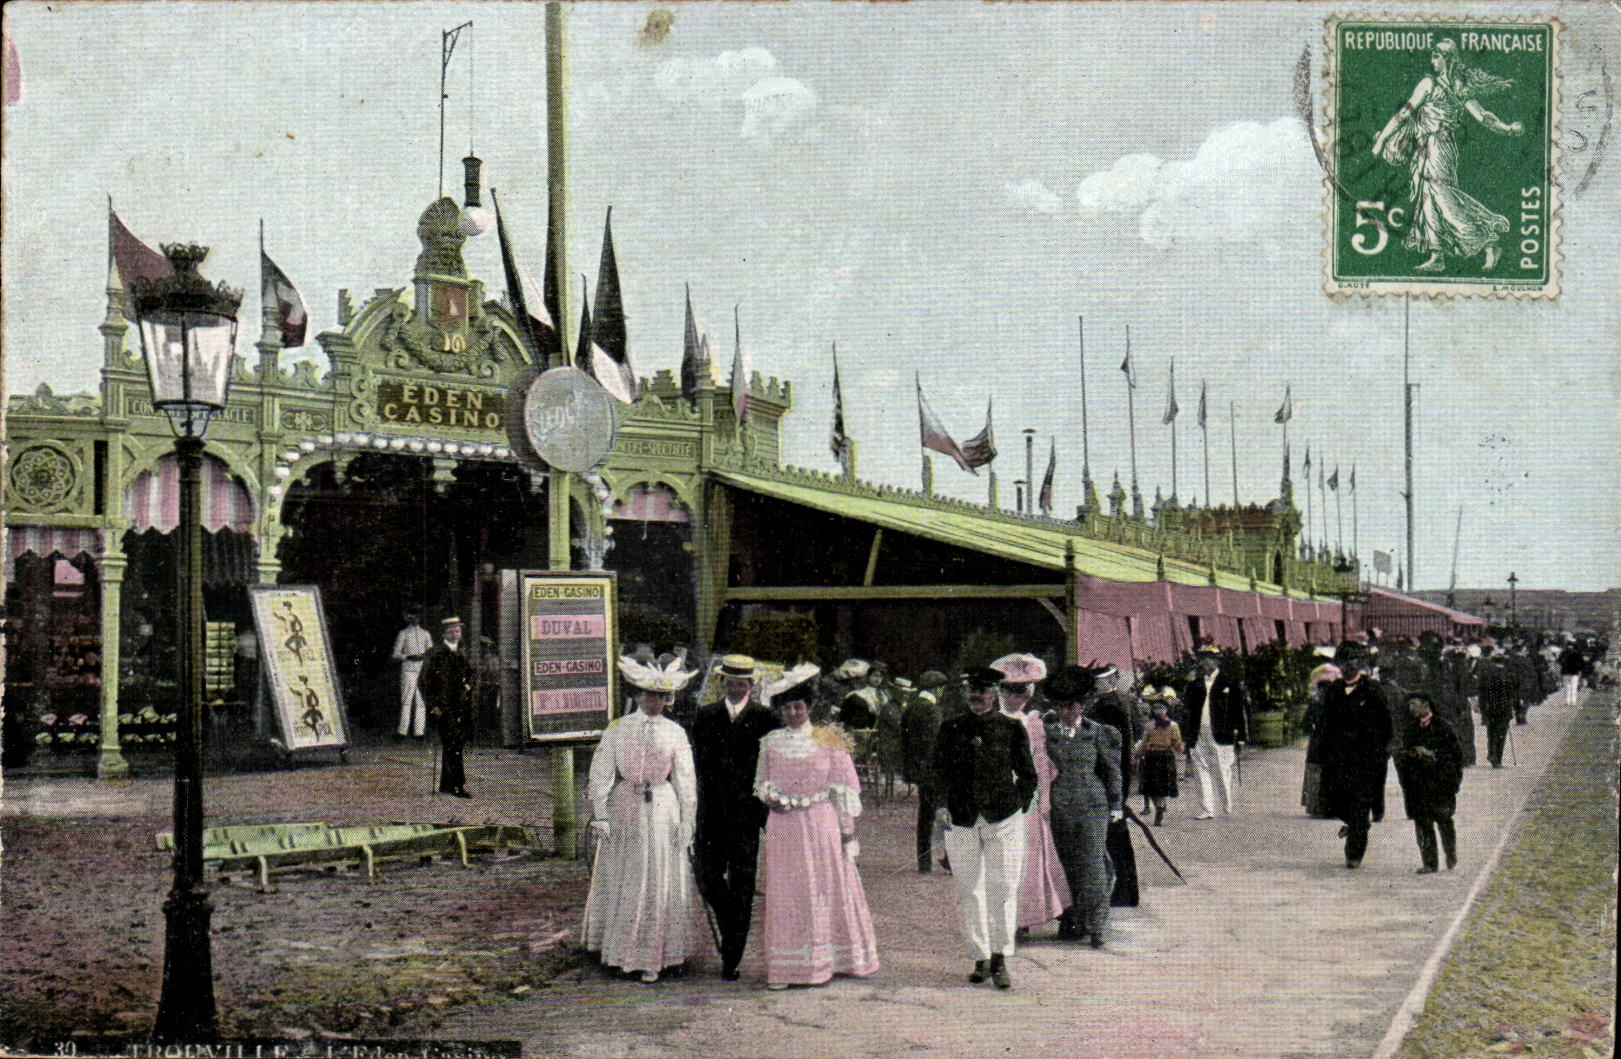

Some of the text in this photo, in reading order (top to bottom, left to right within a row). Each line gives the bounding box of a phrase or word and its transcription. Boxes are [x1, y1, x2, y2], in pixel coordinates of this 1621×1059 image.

[1345, 31, 1543, 54] REPUBLIQUE FRANÇAISE
[1520, 187, 1541, 269] POSTES
[402, 385, 483, 410] EDEN
[384, 403, 501, 428] CASINO
[541, 620, 592, 636] DUVAL
